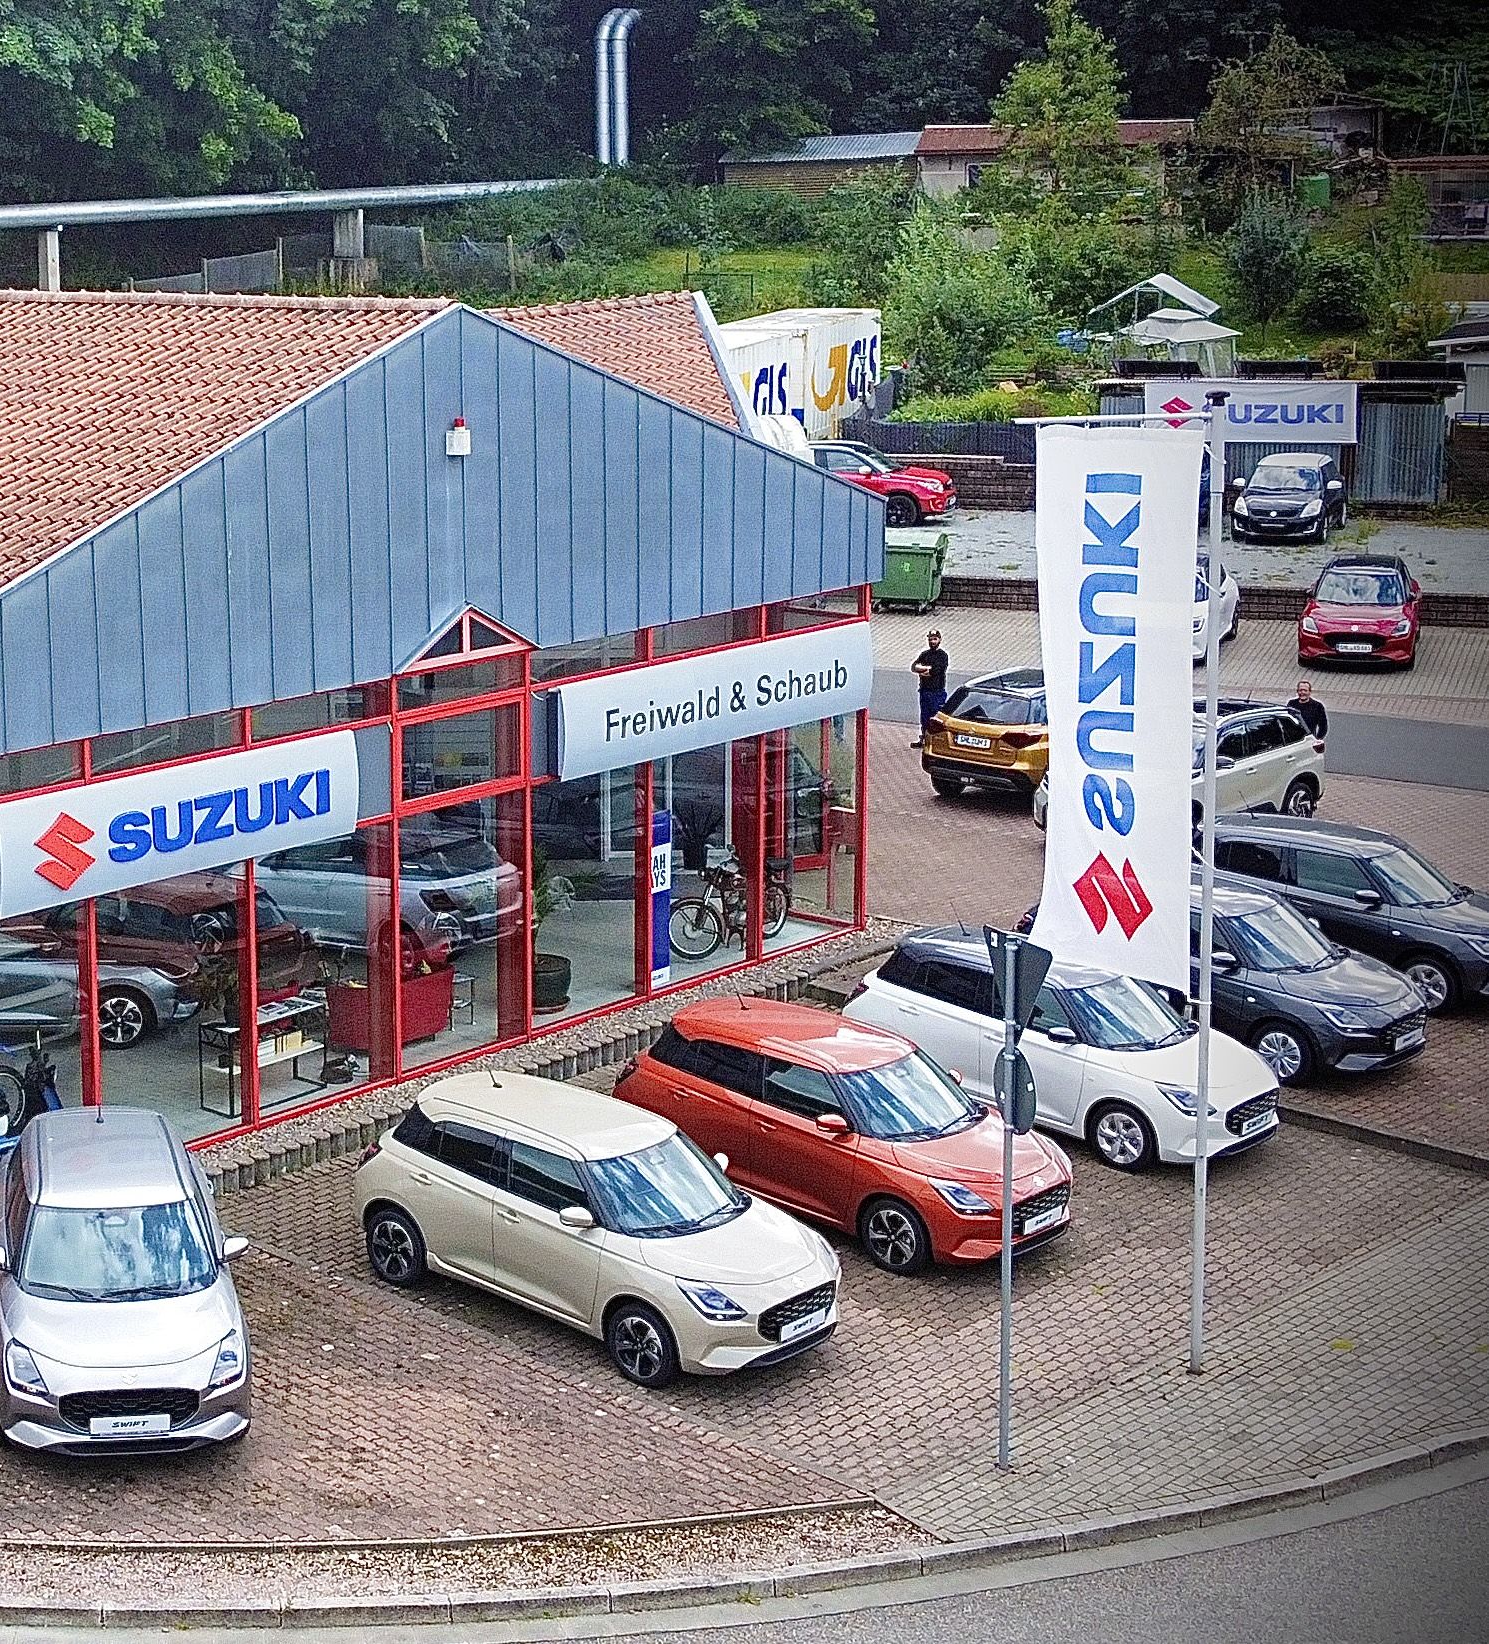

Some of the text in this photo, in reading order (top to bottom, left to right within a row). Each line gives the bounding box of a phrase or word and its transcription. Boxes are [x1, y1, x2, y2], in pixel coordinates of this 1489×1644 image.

[1203, 403, 1344, 424] UZUKI
[605, 659, 848, 742] Freiwald & Schaub
[108, 768, 331, 863] SUZUKI
[652, 853, 666, 872] AH
[651, 869, 666, 888] YS
[111, 1420, 149, 1429] SWIFT
